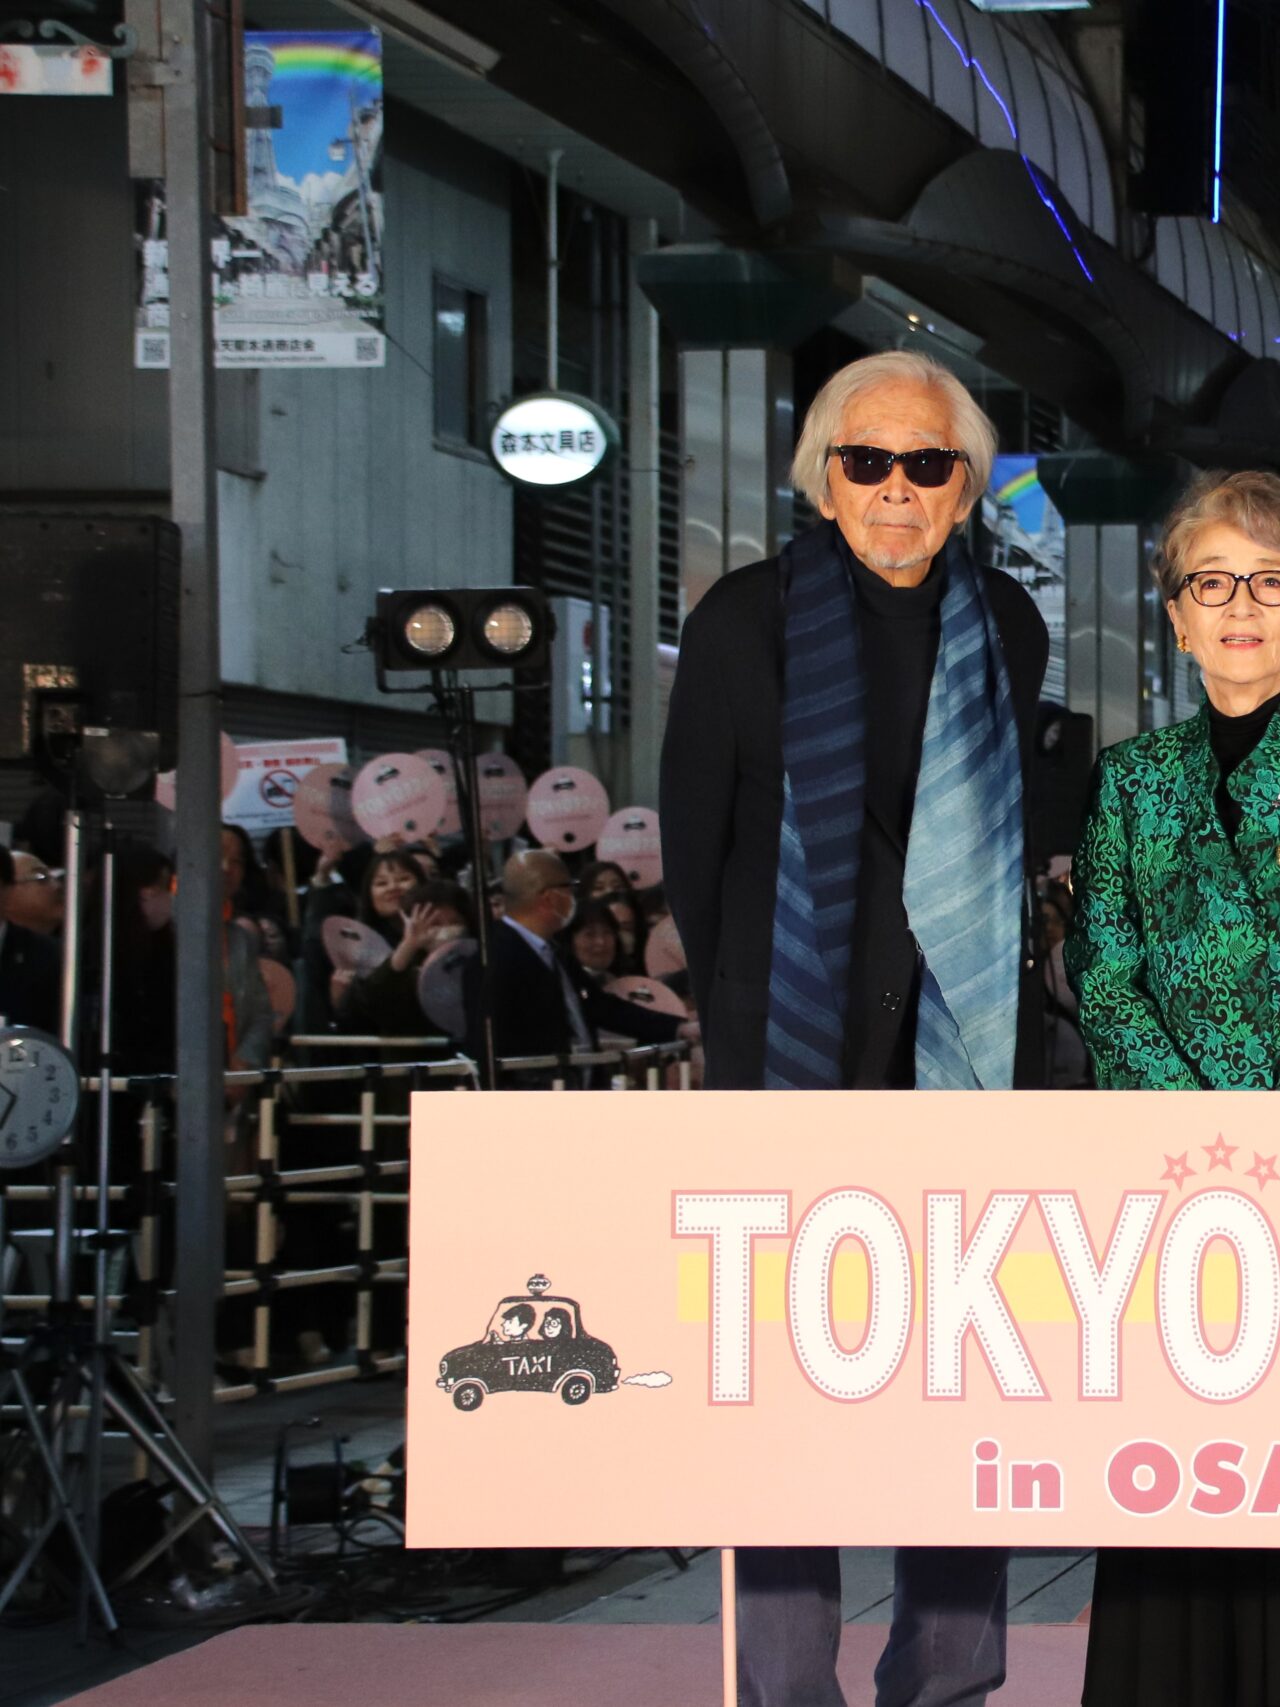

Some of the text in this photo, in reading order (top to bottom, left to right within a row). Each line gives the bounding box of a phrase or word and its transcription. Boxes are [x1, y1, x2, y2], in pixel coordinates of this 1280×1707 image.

[501, 430, 595, 455] 森本文具店
[502, 1355, 552, 1376] TAXI
[972, 1439, 1064, 1512] in
